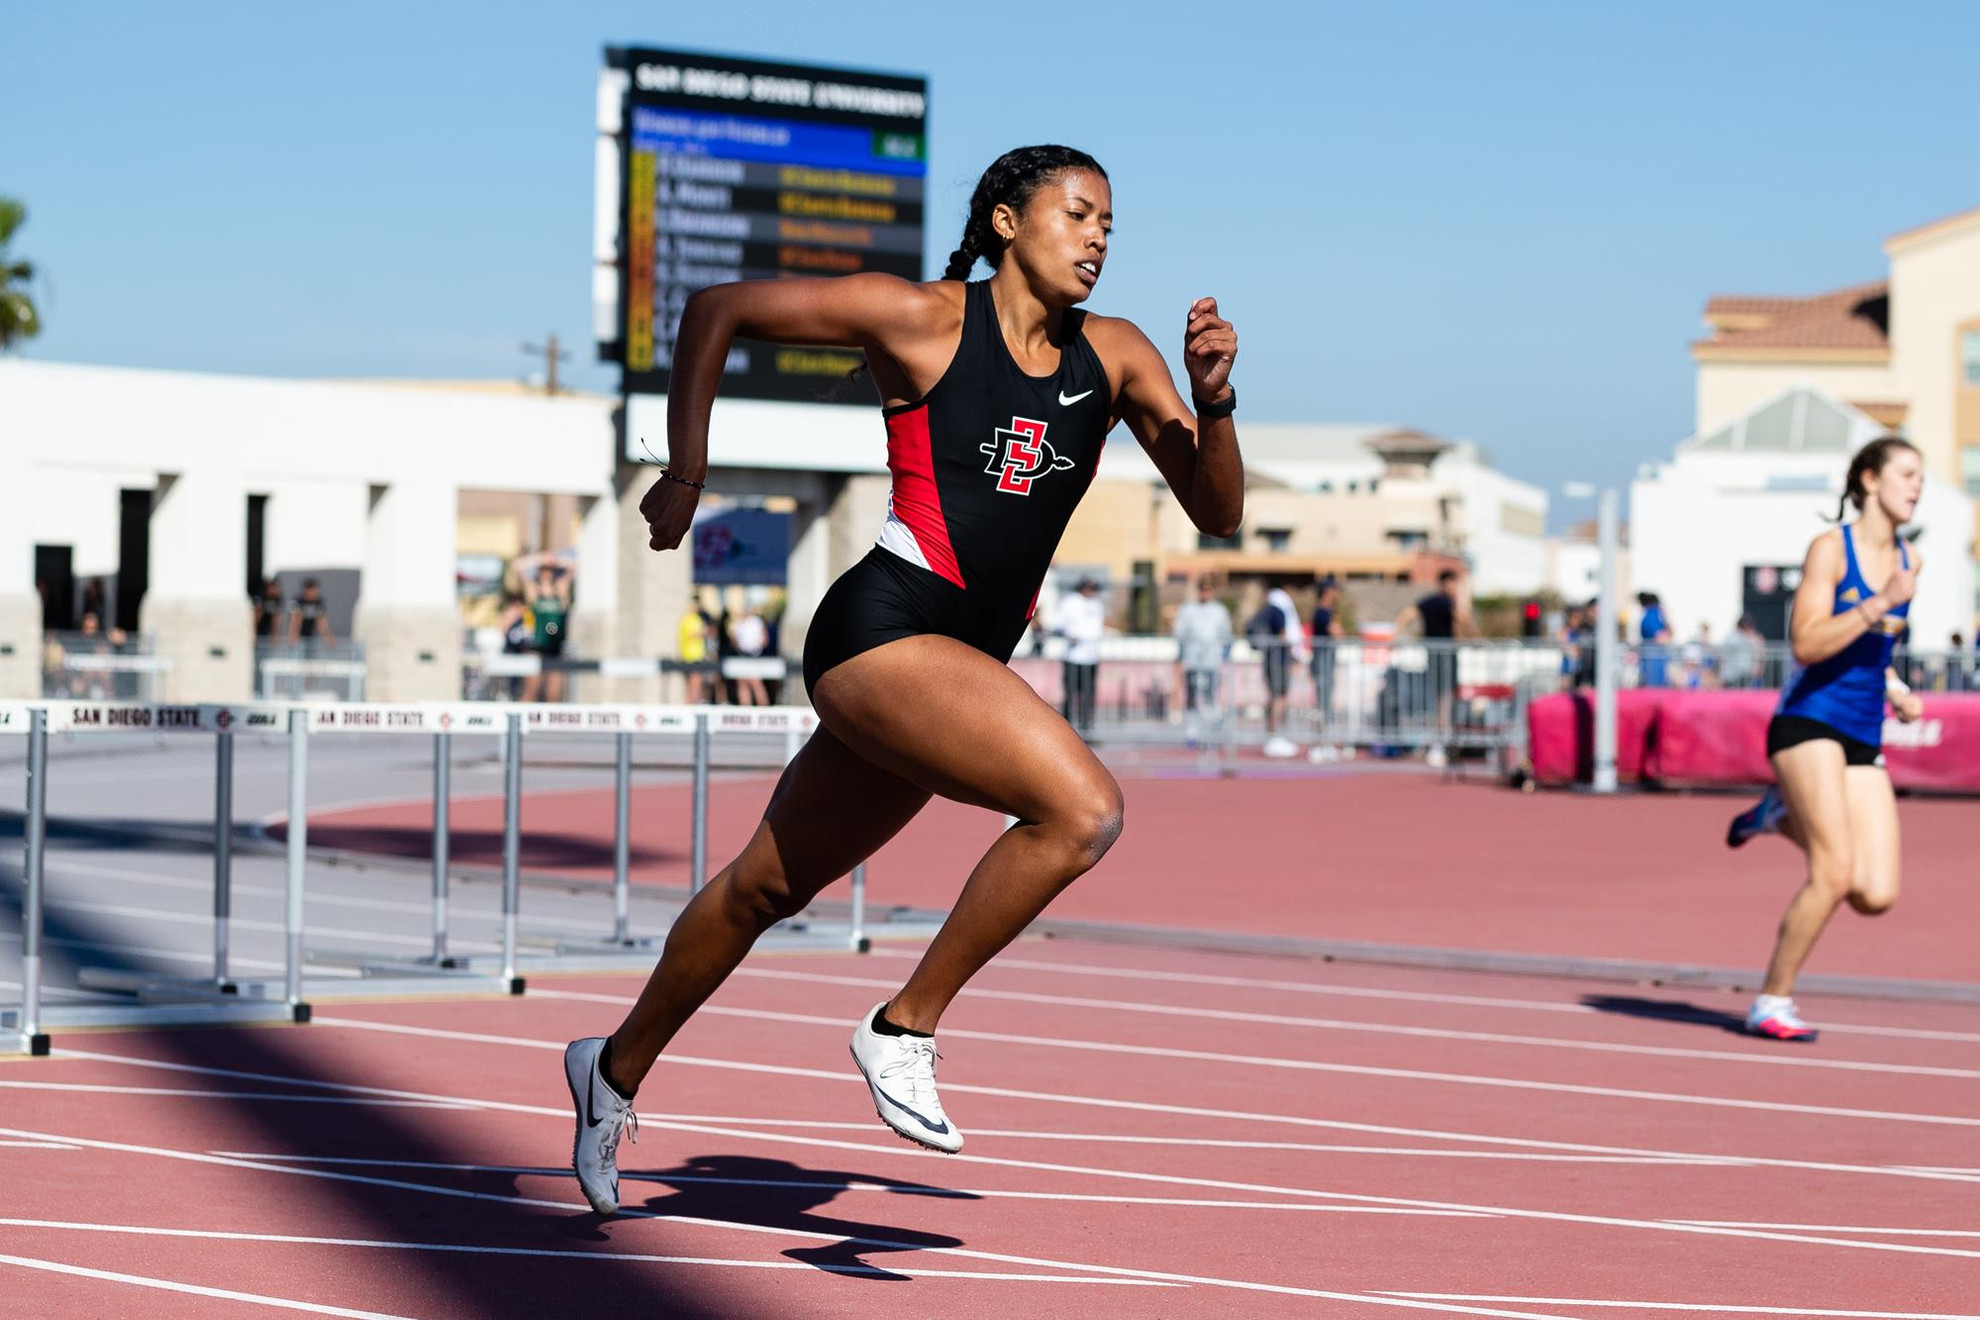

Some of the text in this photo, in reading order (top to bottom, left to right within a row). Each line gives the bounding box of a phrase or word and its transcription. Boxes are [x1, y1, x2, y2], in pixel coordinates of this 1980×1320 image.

[73, 708, 200, 727] SAN DIEGO STATE
